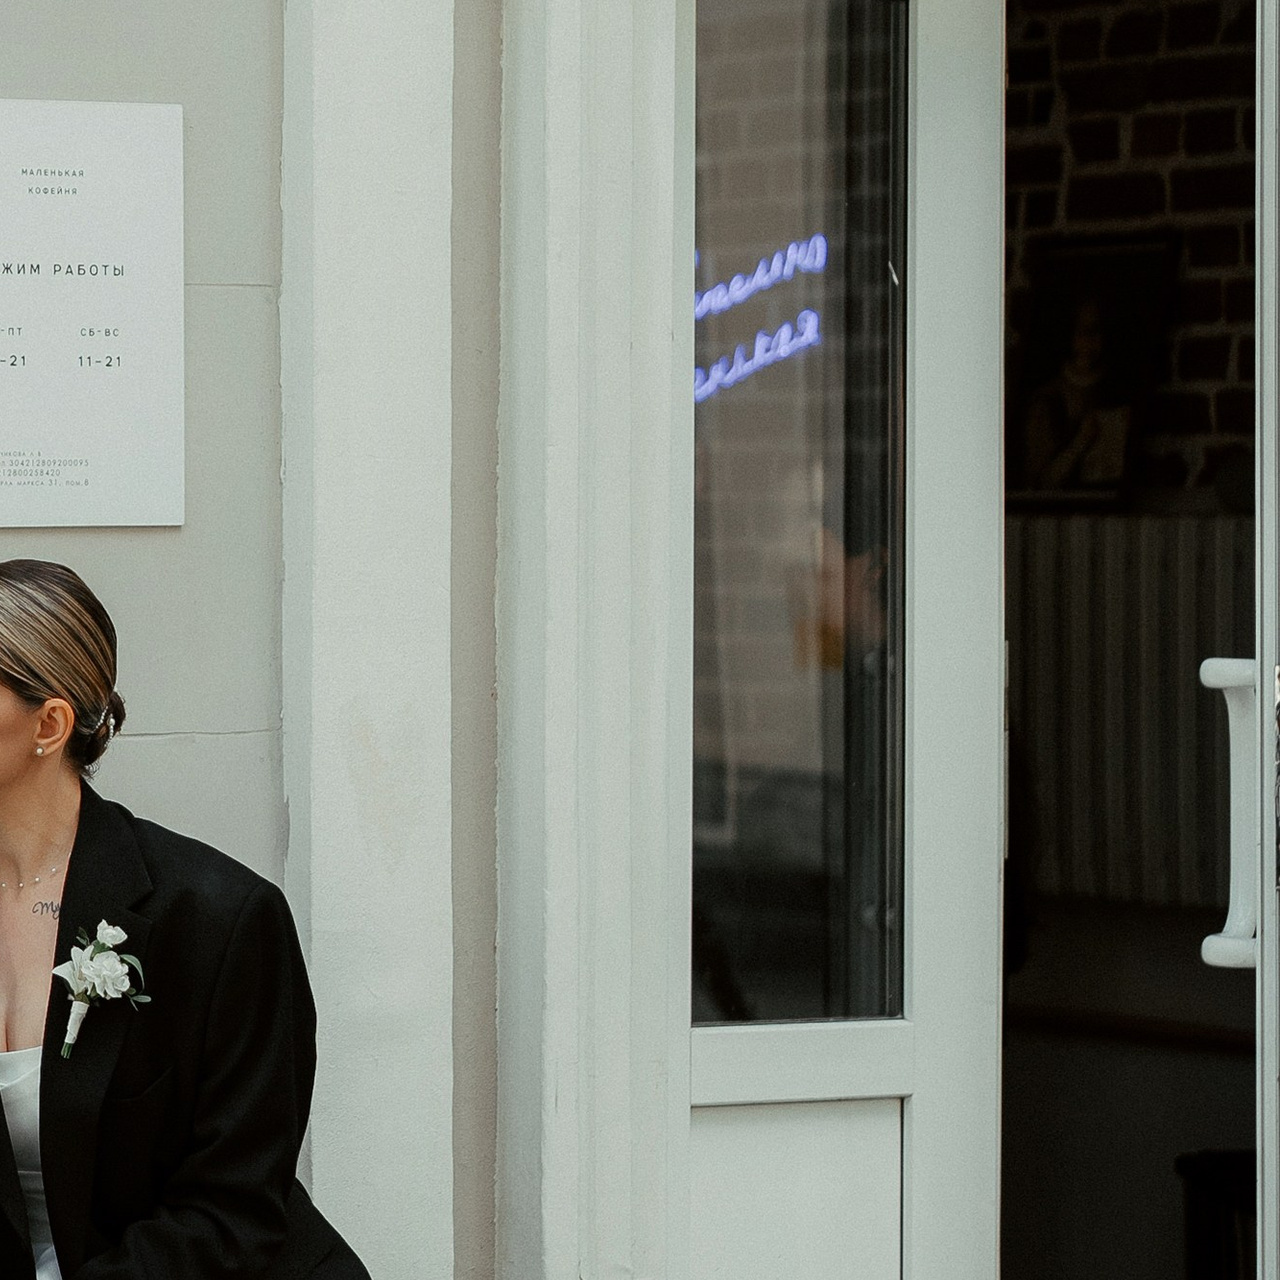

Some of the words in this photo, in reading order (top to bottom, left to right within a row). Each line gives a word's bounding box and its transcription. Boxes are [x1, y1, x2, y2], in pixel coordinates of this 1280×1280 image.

[21, 168, 84, 177] МАЛЕНЬКАЯ
[28, 185, 78, 195] КОФЕЙНЯ
[53, 263, 125, 277] РАБОТЫ
[80, 327, 119, 337] СБ-ВС
[78, 355, 122, 368] 11-21
